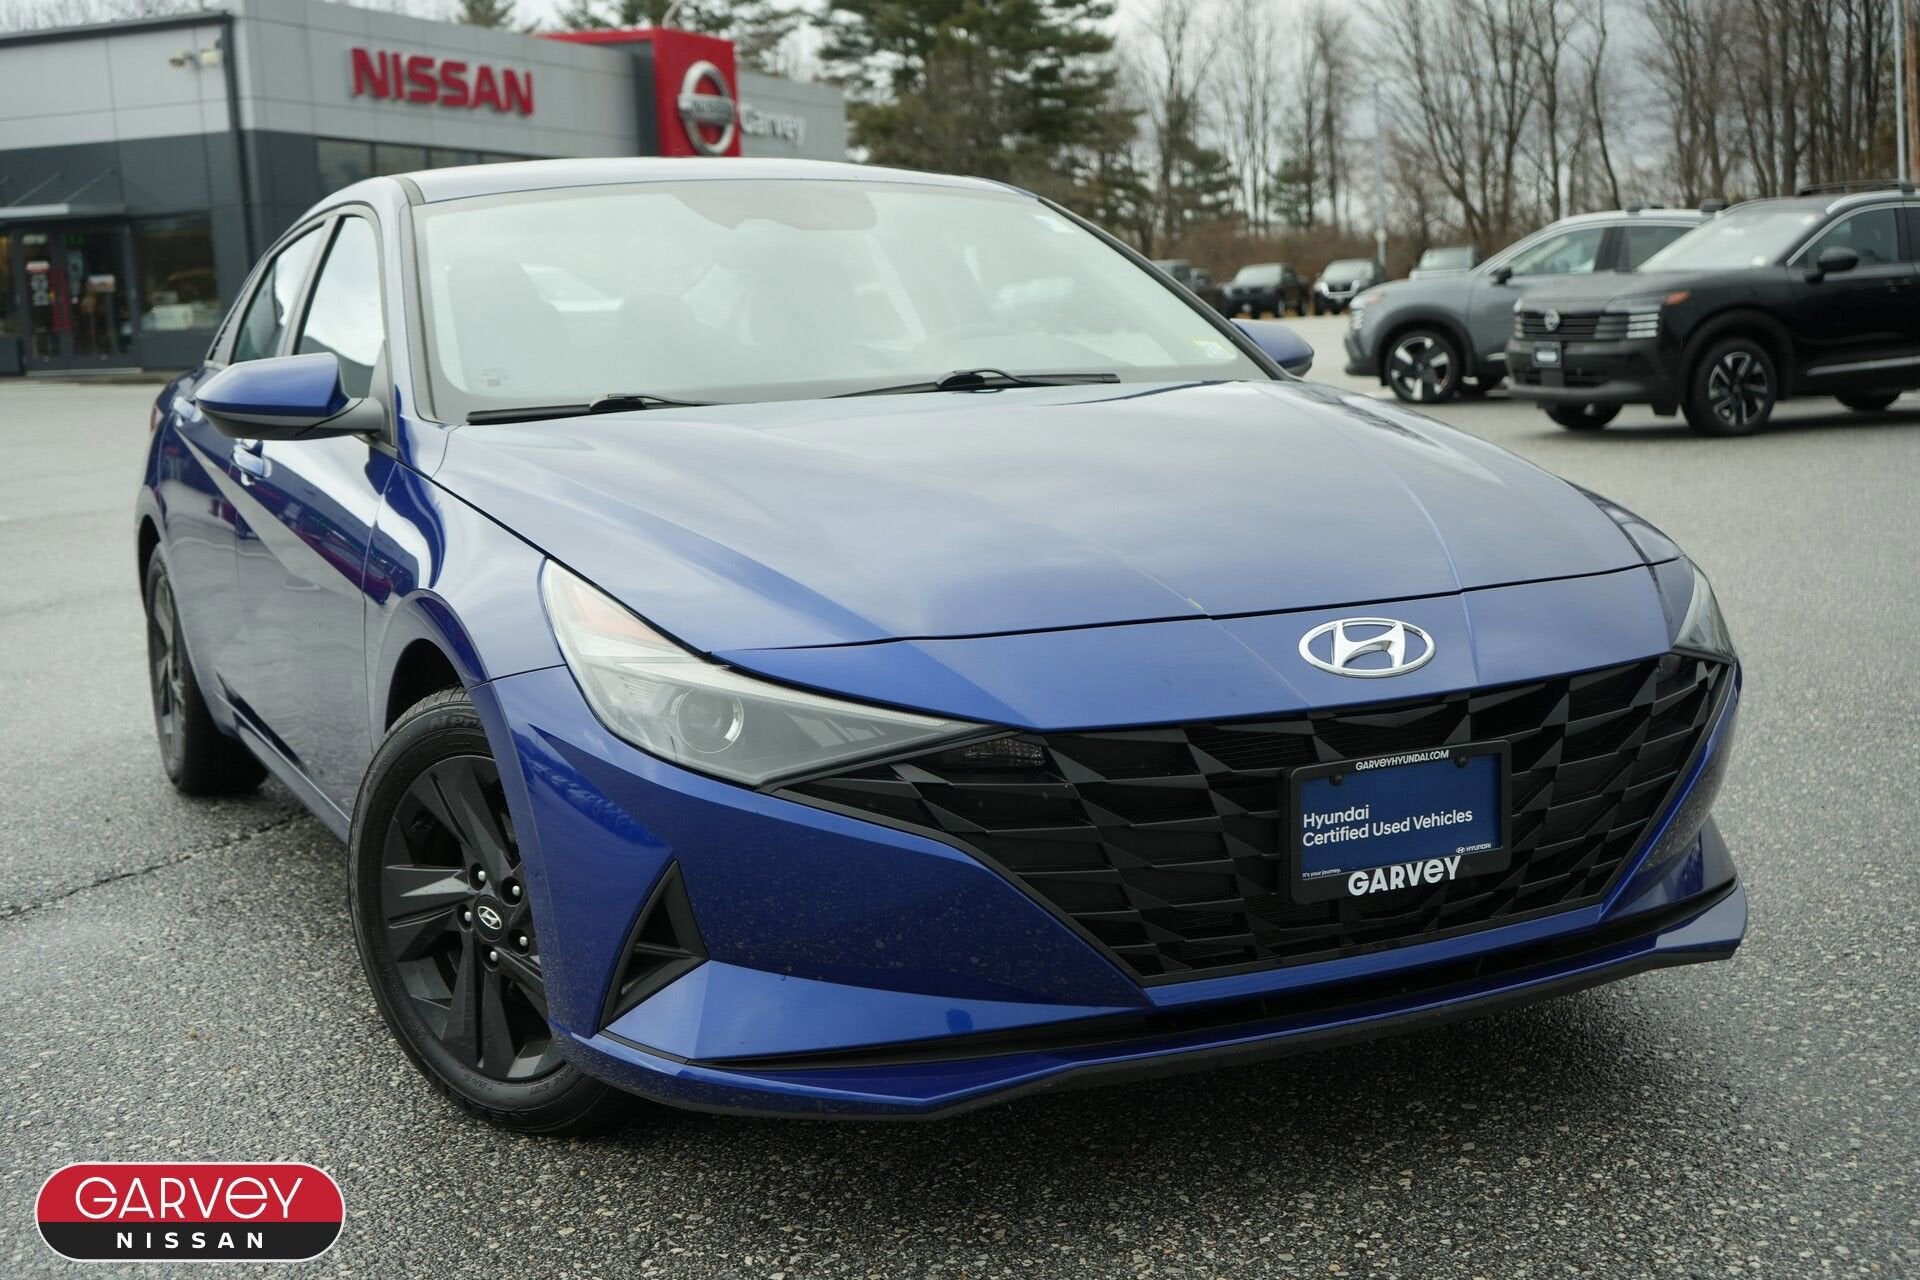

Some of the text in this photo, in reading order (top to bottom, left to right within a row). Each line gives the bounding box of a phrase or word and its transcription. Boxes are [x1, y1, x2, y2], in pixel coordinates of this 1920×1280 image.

[351, 47, 536, 117] NISSAN
[740, 103, 805, 146] Garvey
[1302, 808, 1473, 847] Certified Used Vehicles
[1303, 805, 1369, 830] Hyundai
[1465, 843, 1492, 853] HYUNDAI
